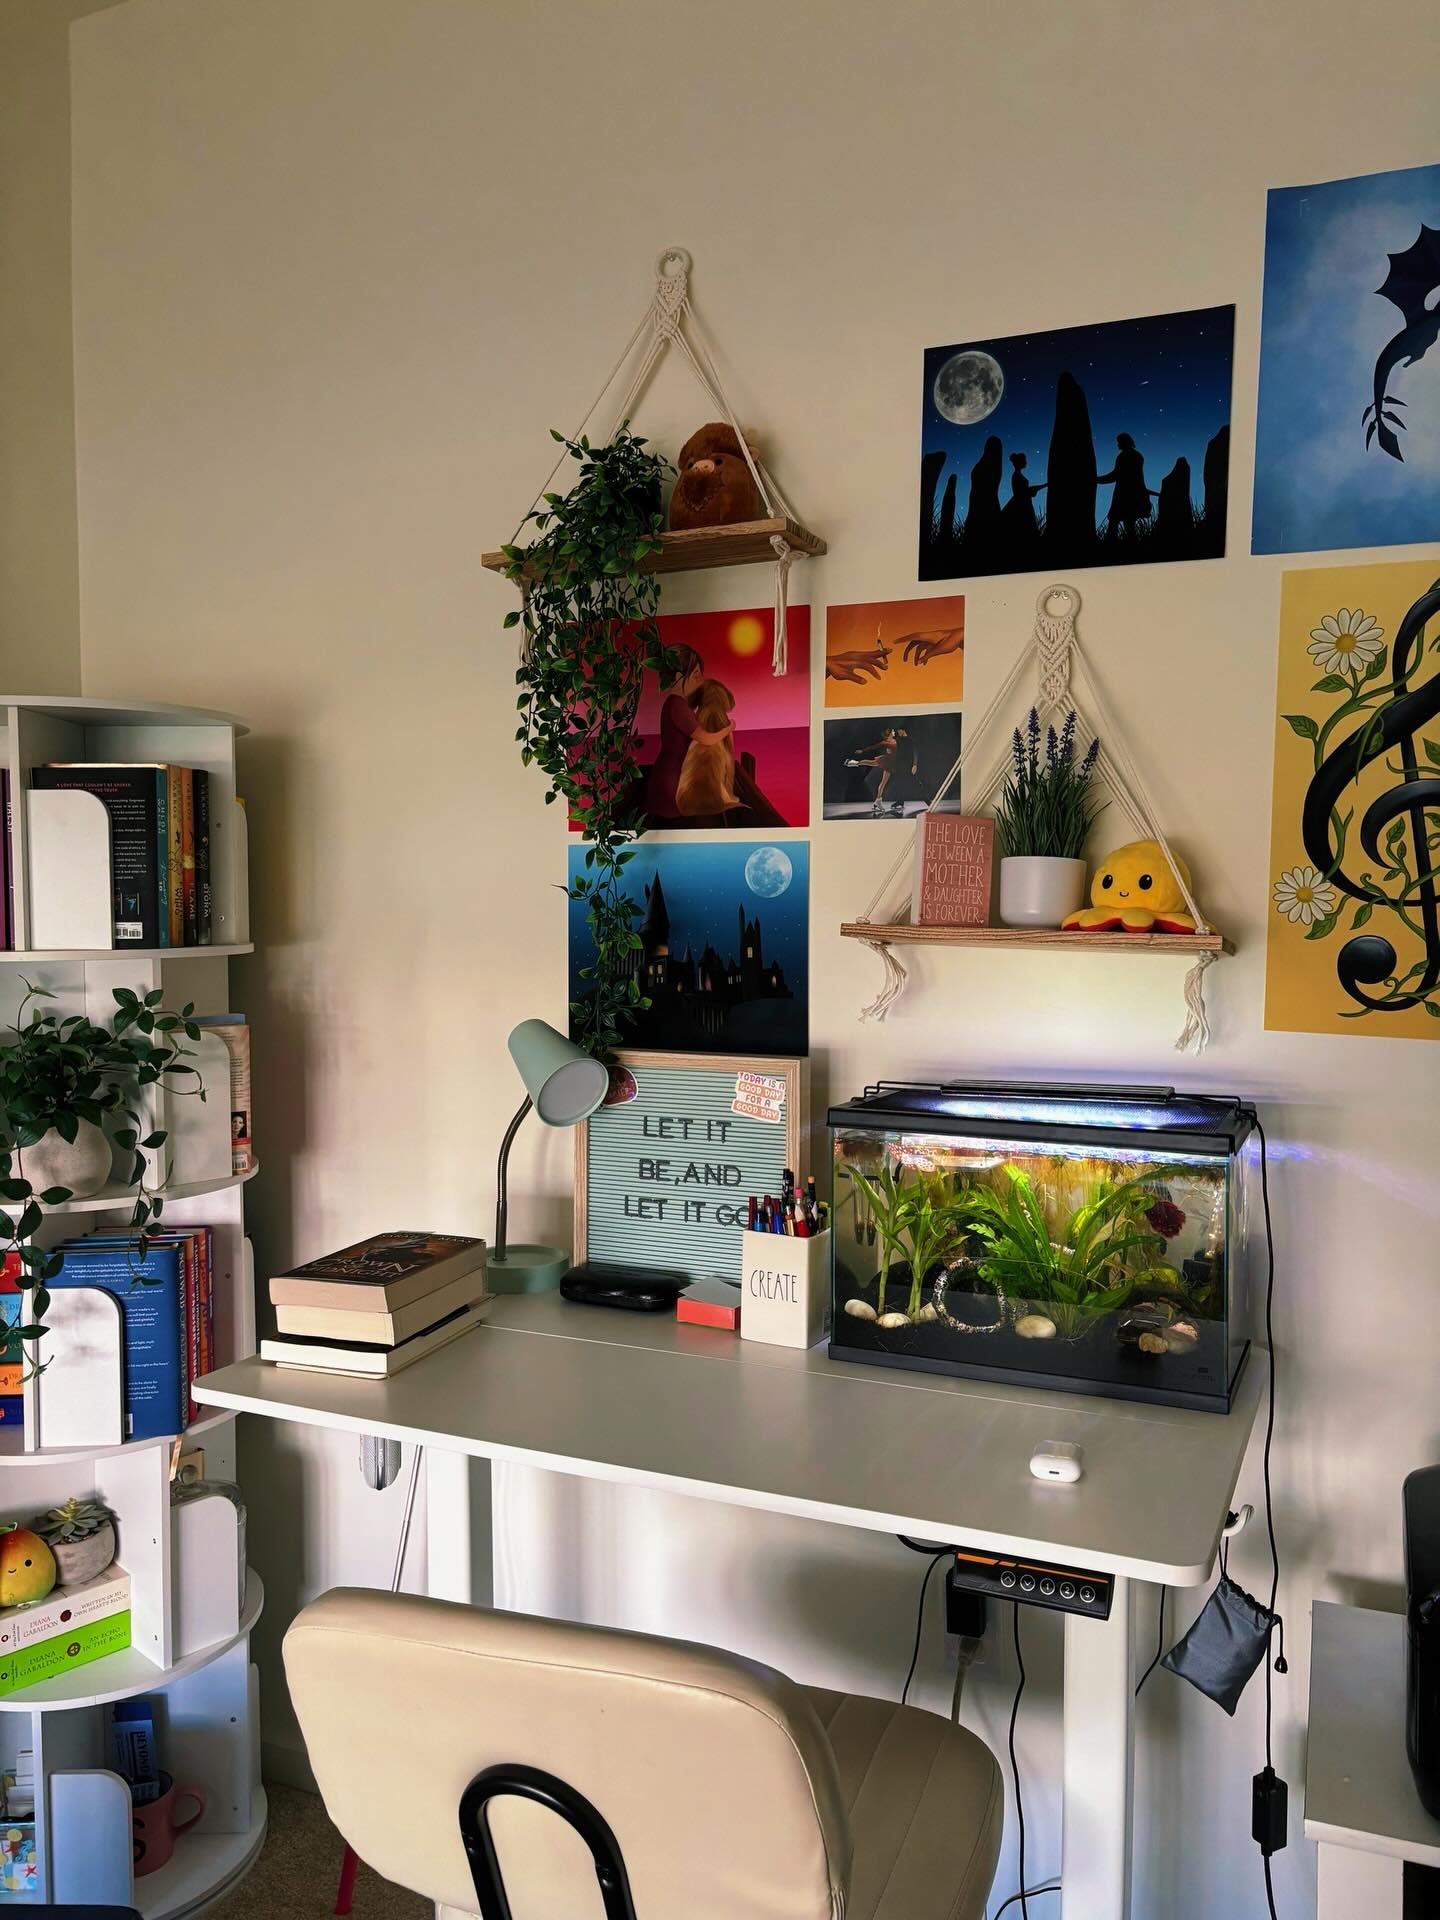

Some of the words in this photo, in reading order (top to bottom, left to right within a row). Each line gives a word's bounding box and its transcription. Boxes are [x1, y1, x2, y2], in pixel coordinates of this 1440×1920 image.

[924, 821, 951, 844] THE
[954, 823, 986, 846] LOVE
[926, 842, 973, 863] BETWEEN
[976, 848, 985, 864] A
[925, 862, 985, 888] MOTHER
[923, 885, 931, 901] &
[933, 886, 983, 905] DAUGHTER
[922, 903, 931, 920] IS
[935, 903, 980, 924] FOREVER
[740, 1072, 767, 1086] TODAY
[768, 1079, 777, 1088] IS
[778, 1082, 785, 1091] A
[740, 1082, 762, 1095] GOOD
[764, 1089, 781, 1099] DAY
[736, 1102, 759, 1115] GOOD
[760, 1108, 778, 1119] DAY
[745, 1094, 762, 1105] FOR
[764, 1099, 771, 1108] A
[642, 1115, 693, 1140] LET
[706, 1119, 732, 1144] IT
[624, 1194, 668, 1221] LET
[683, 1200, 706, 1223] IT
[750, 1269, 798, 1304] CREATE
[73, 1609, 88, 1618] OWN
[110, 1594, 129, 1604] BLOOD
[81, 1596, 106, 1609] WRITTEN
[23, 1620, 59, 1638] GABALDON
[30, 1616, 51, 1629] DIANA
[83, 1645, 92, 1653] IN
[92, 1638, 107, 1650] THE
[108, 1631, 127, 1643] BONE
[89, 1635, 98, 1643] AN
[100, 1627, 120, 1638] ECHO
[20, 1655, 65, 1677] GABALDON
[29, 1650, 56, 1665] DIANA
